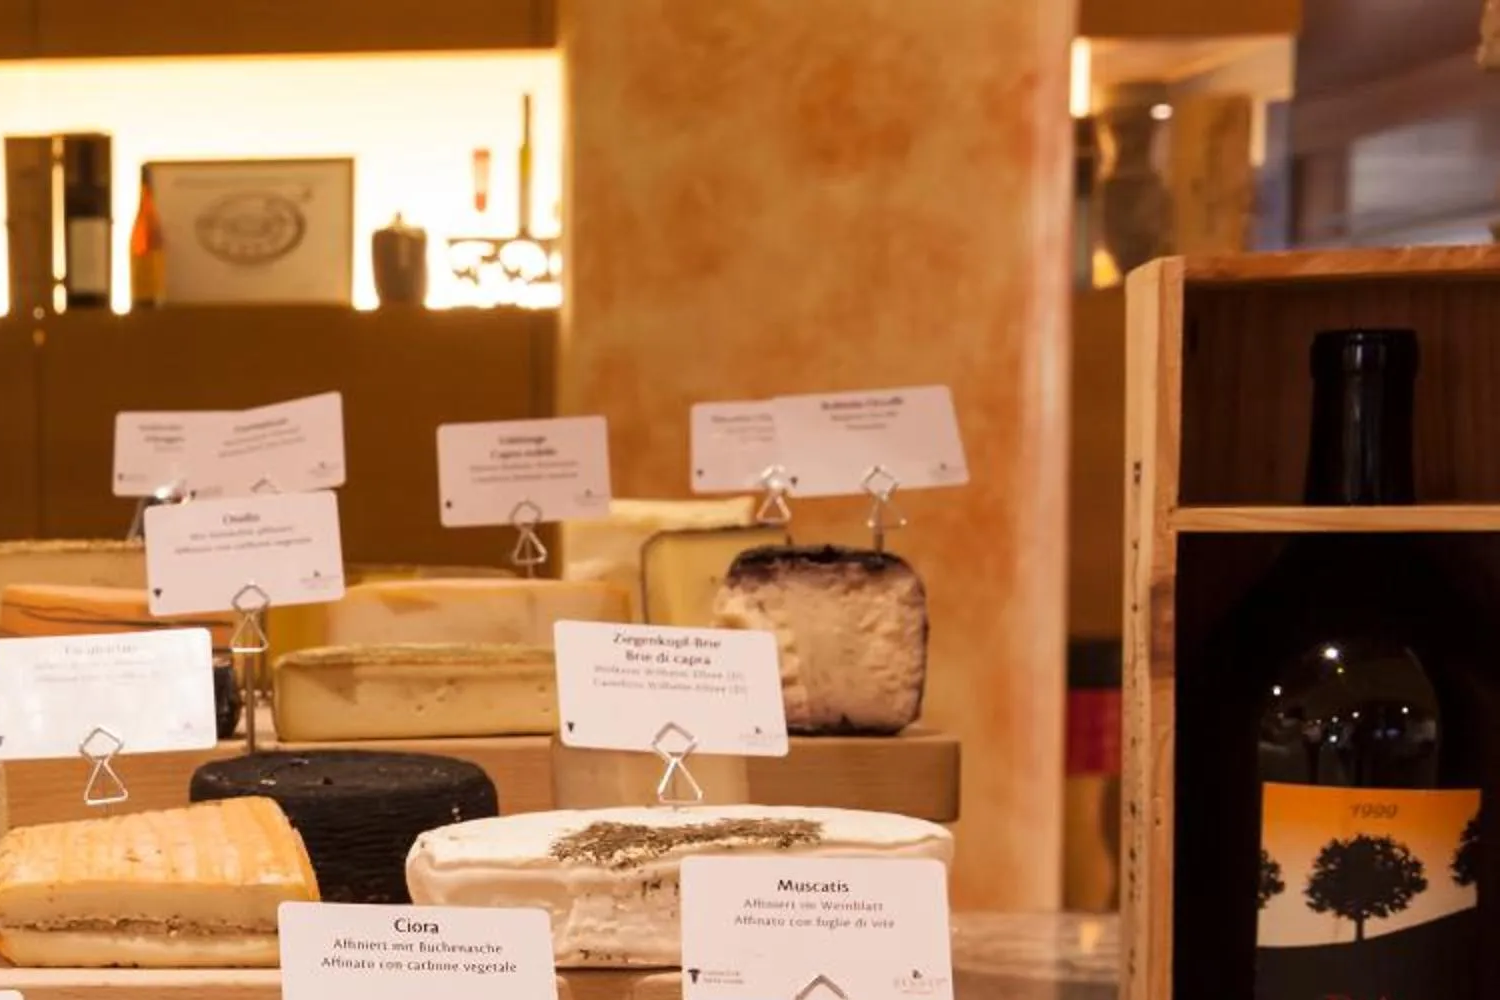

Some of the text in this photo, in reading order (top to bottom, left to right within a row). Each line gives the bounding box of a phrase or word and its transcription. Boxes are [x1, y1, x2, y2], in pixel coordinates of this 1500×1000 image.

[777, 879, 850, 893] Muscatis
[394, 918, 439, 934] Ciora
[734, 915, 784, 927] Affinato
[321, 957, 375, 969] Affinato
[463, 961, 517, 974] vegetale
